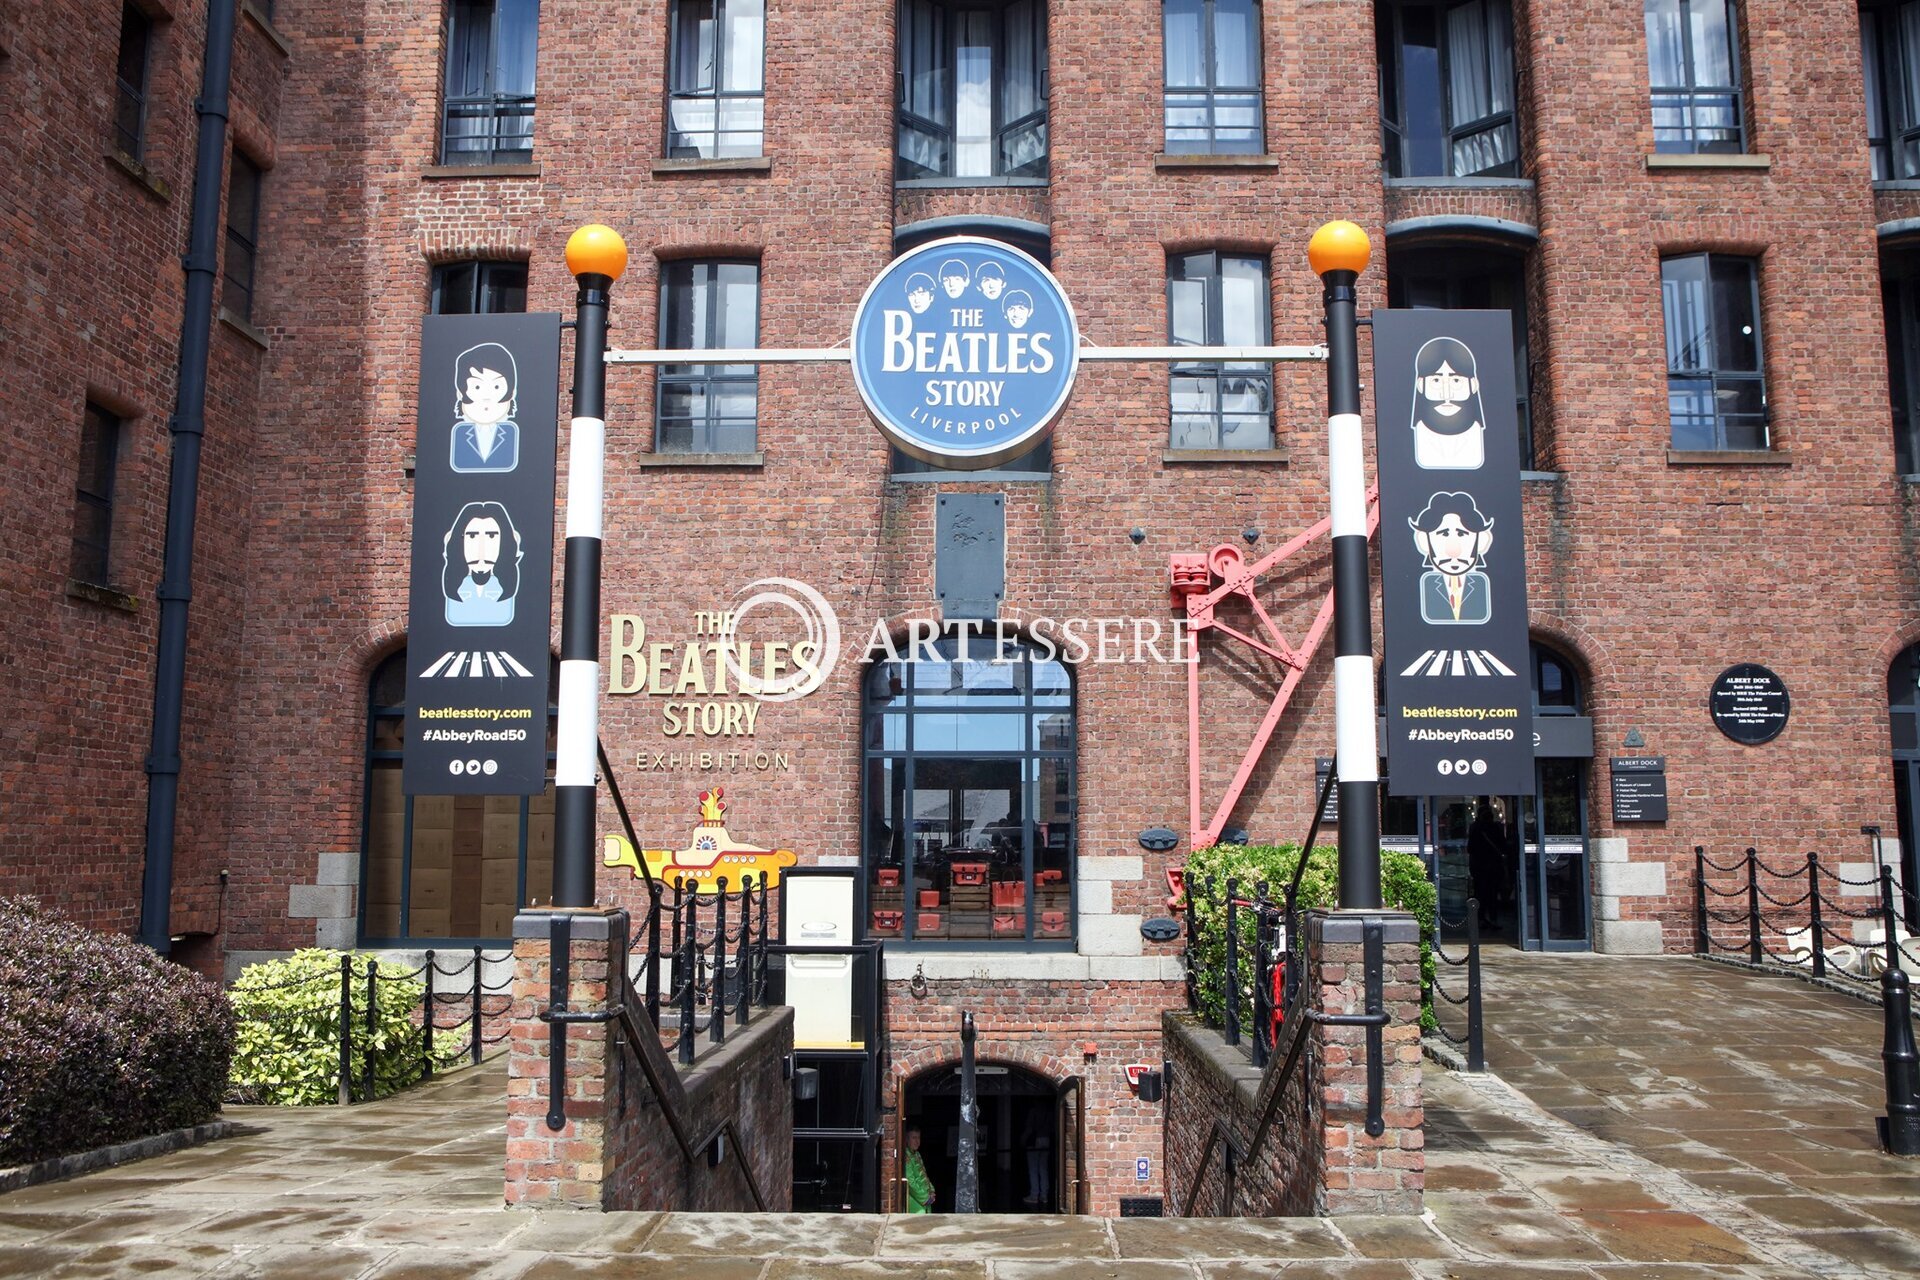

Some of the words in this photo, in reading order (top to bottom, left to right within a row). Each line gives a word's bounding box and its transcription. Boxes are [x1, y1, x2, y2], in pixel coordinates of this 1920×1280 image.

[951, 308, 984, 327] THE
[881, 310, 1054, 374] BEATLES
[925, 380, 1005, 406] STORY
[910, 407, 1021, 434] LIVERPOOL
[694, 612, 735, 635] THE
[607, 614, 822, 696] BEATLES
[419, 707, 532, 721] beatlesstory.com
[662, 702, 761, 736] STORY
[1402, 706, 1518, 721] beatlesstory.com
[423, 729, 527, 743] #AbbeyRoad50
[1408, 729, 1514, 743] #AbbeyRoad50
[636, 752, 789, 770] EXHIBITION
